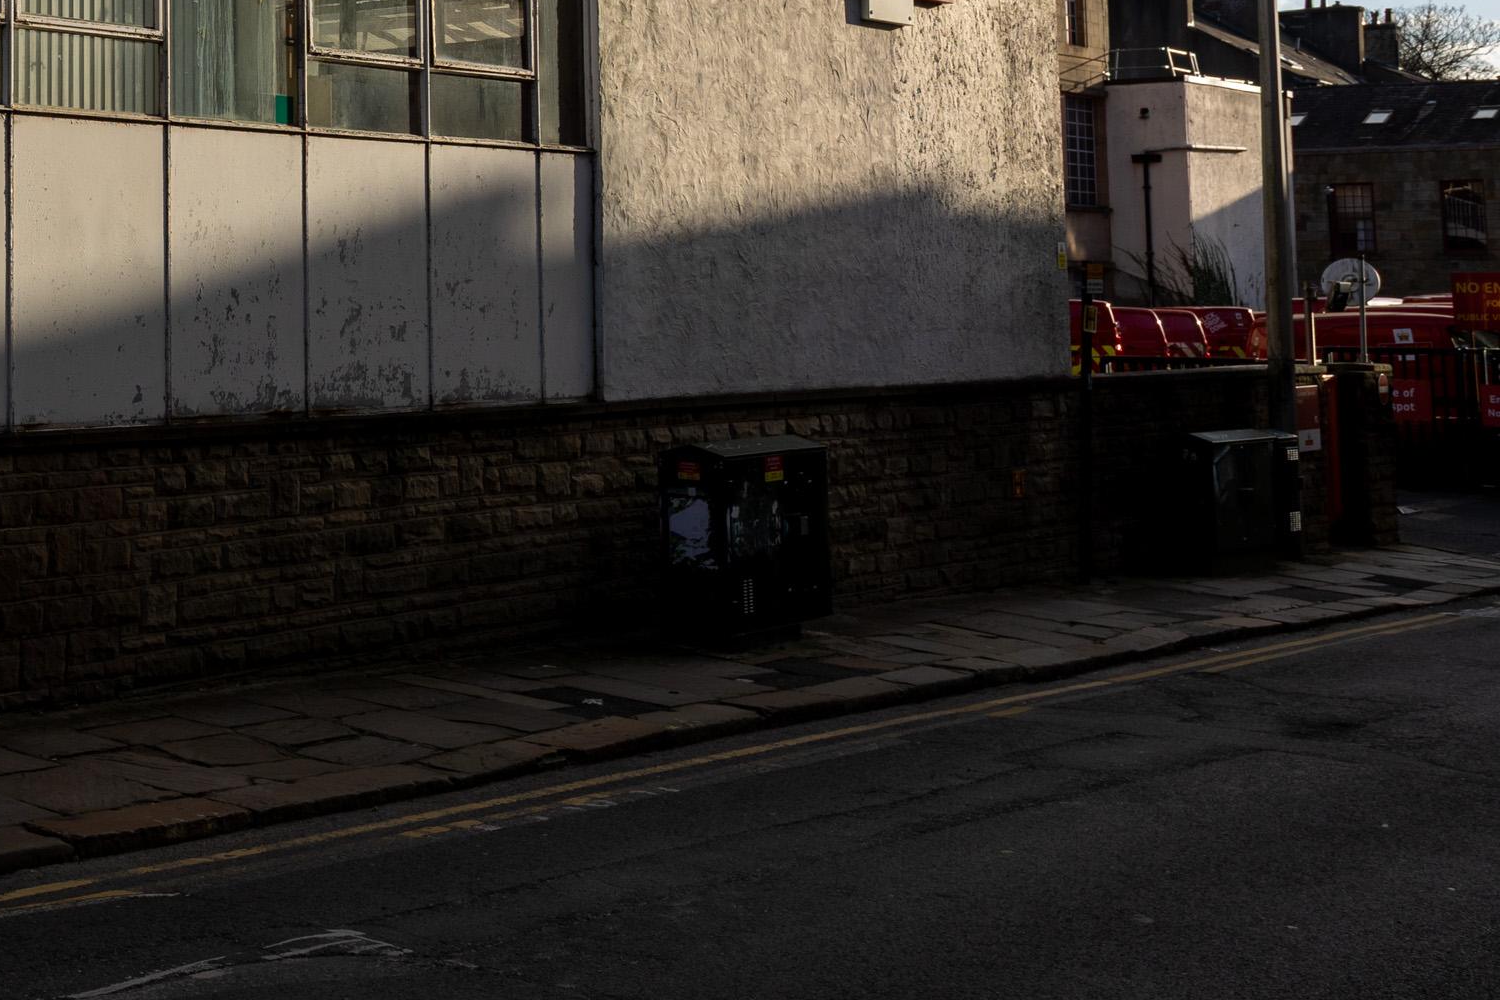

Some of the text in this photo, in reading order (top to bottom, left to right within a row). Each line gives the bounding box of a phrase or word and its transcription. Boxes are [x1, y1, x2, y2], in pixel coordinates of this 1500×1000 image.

[1455, 281, 1480, 294] NO
[1455, 313, 1490, 321] PUBLIC
[1403, 387, 1415, 398] of
